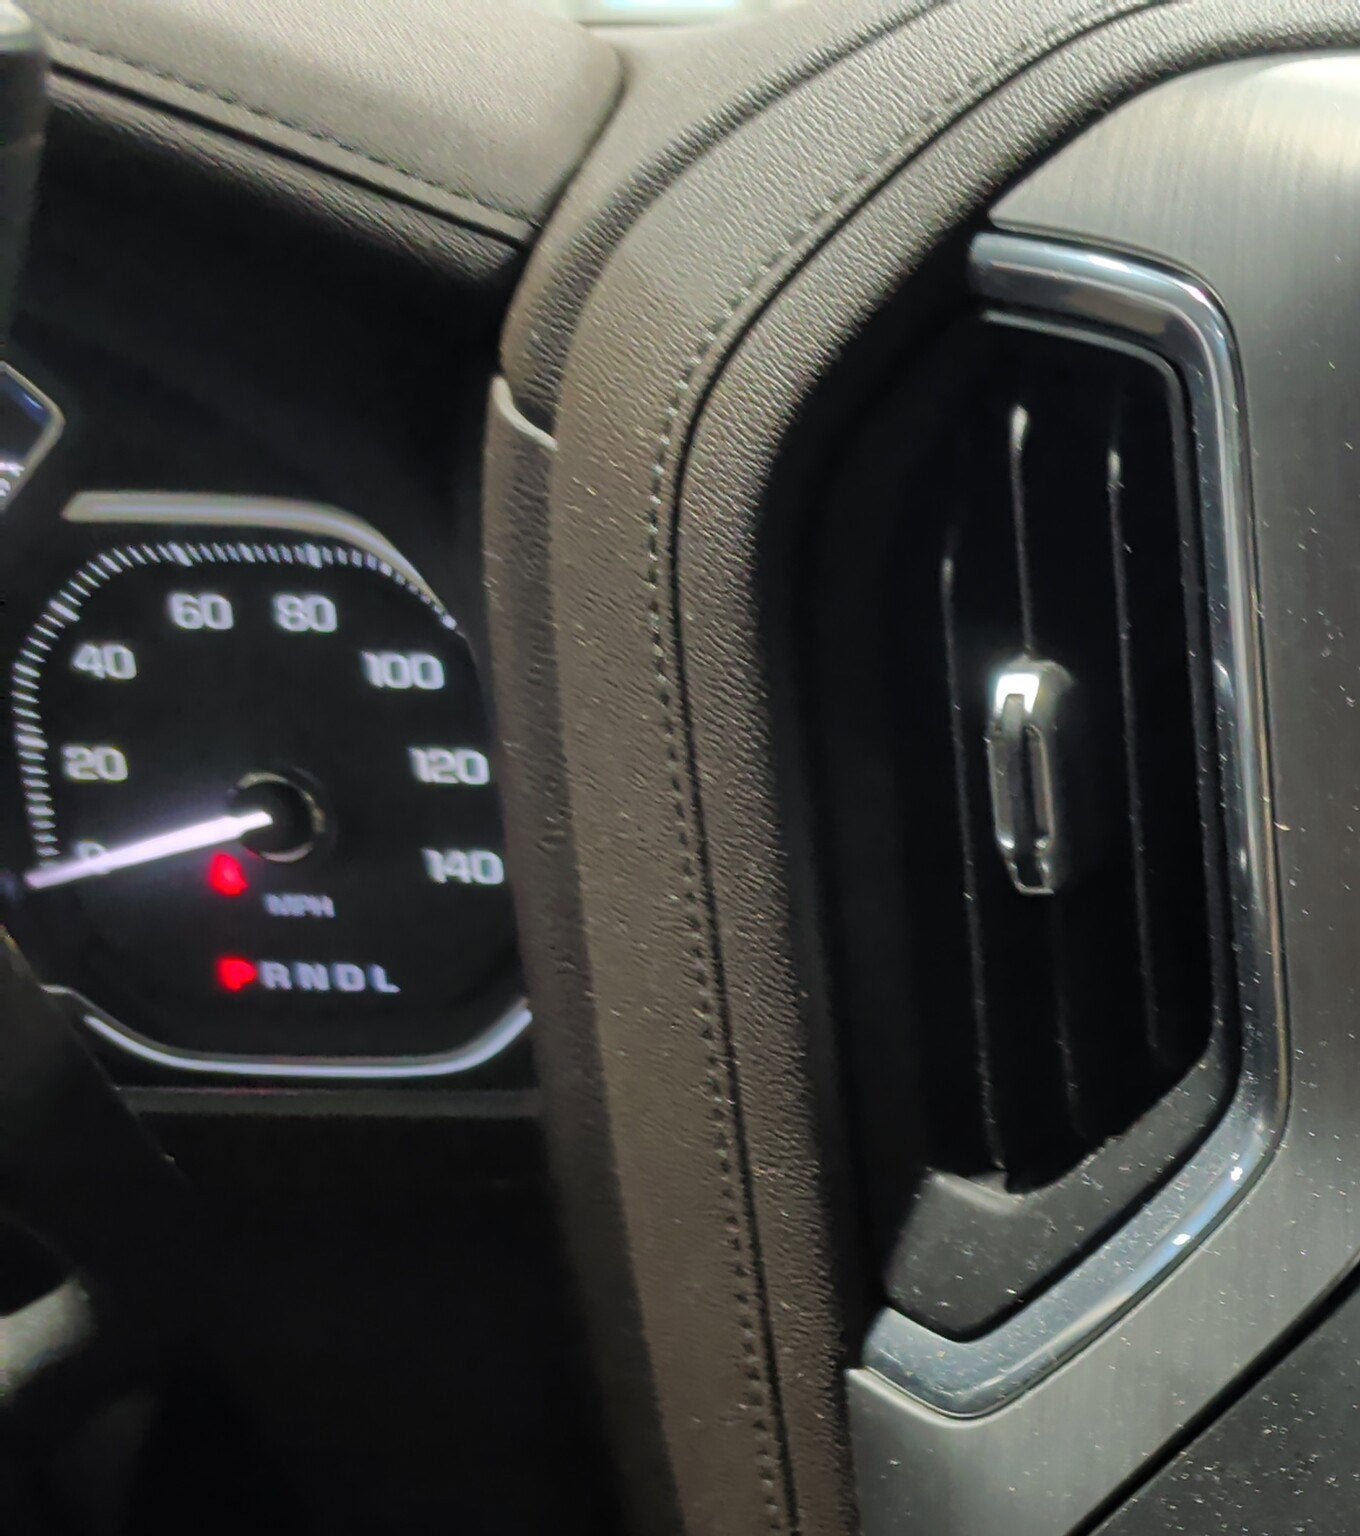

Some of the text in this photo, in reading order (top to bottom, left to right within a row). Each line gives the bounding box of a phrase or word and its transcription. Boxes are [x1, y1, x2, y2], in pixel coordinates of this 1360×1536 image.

[169, 595, 233, 629] 60
[274, 595, 337, 633] 80
[71, 644, 136, 680] 40
[361, 652, 443, 690] 100
[63, 747, 127, 781] 20
[410, 747, 489, 784] 120
[423, 848, 503, 884] 140
